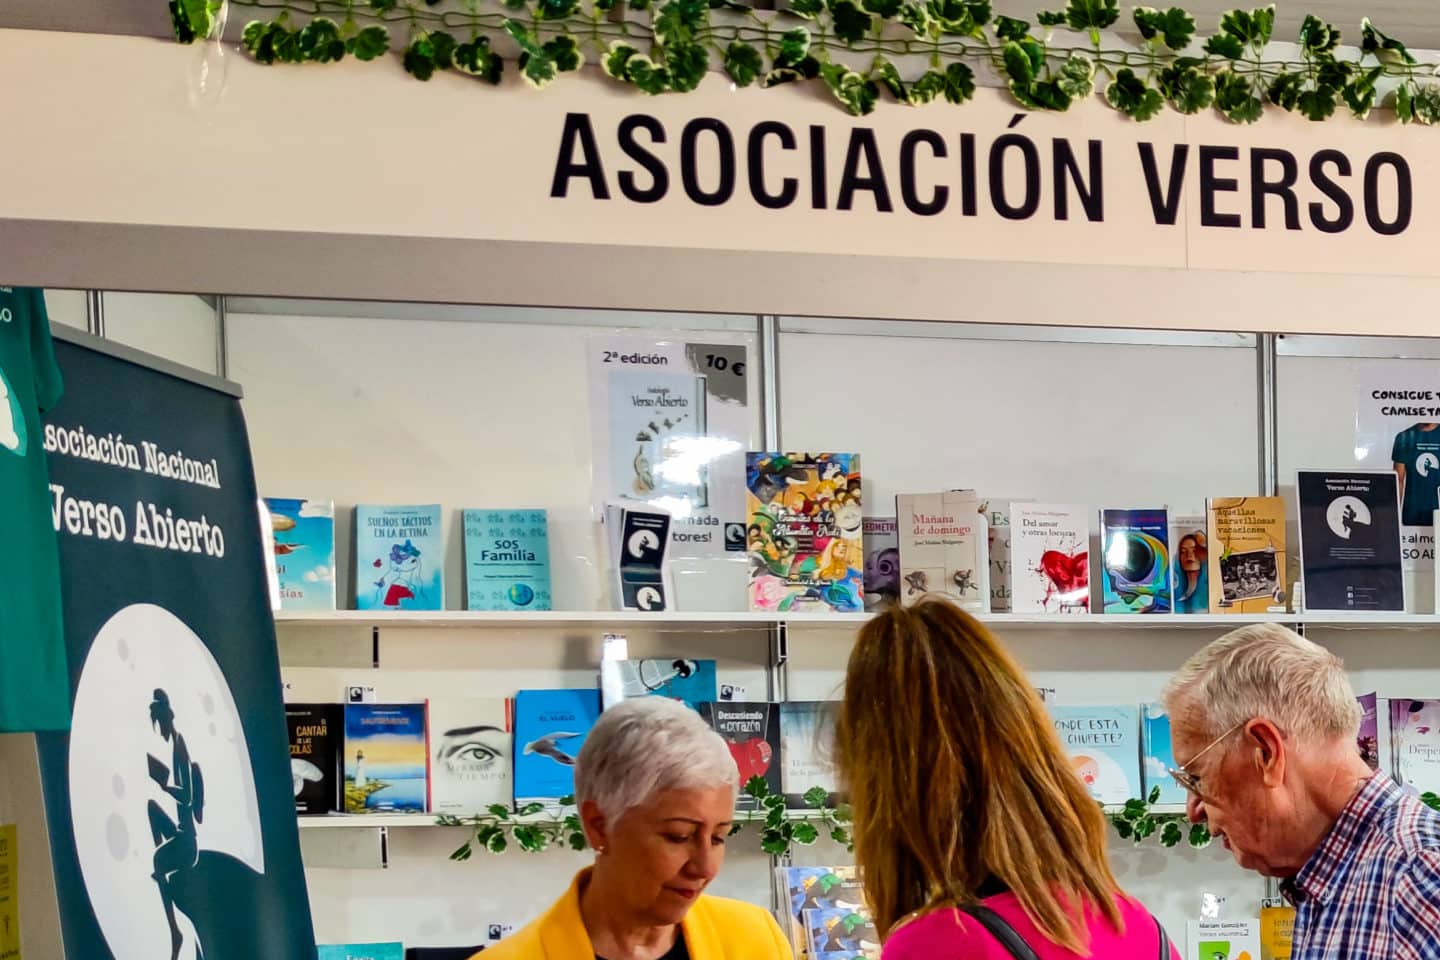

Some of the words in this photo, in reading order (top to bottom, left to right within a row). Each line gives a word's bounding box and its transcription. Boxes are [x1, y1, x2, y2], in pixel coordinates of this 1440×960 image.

[551, 112, 1103, 223] ASOCIACIÓN
[1139, 142, 1413, 236] VERSO
[621, 352, 668, 366] edición
[705, 354, 728, 371] 10
[732, 362, 745, 376] €
[1372, 390, 1433, 401] CONSIGUE
[43, 424, 142, 471] sociación
[141, 441, 222, 489] Nacional
[49, 483, 126, 542] Verso
[133, 500, 225, 558] Abierto
[913, 513, 954, 525] Mañana
[1022, 518, 1036, 528] Del
[671, 531, 712, 543] tores!
[913, 526, 925, 535] de
[927, 525, 972, 537] domingo
[495, 540, 519, 550] SOS
[481, 550, 536, 562] Familia
[296, 725, 328, 737] CANTAR
[1055, 719, 1084, 731] ONDE
